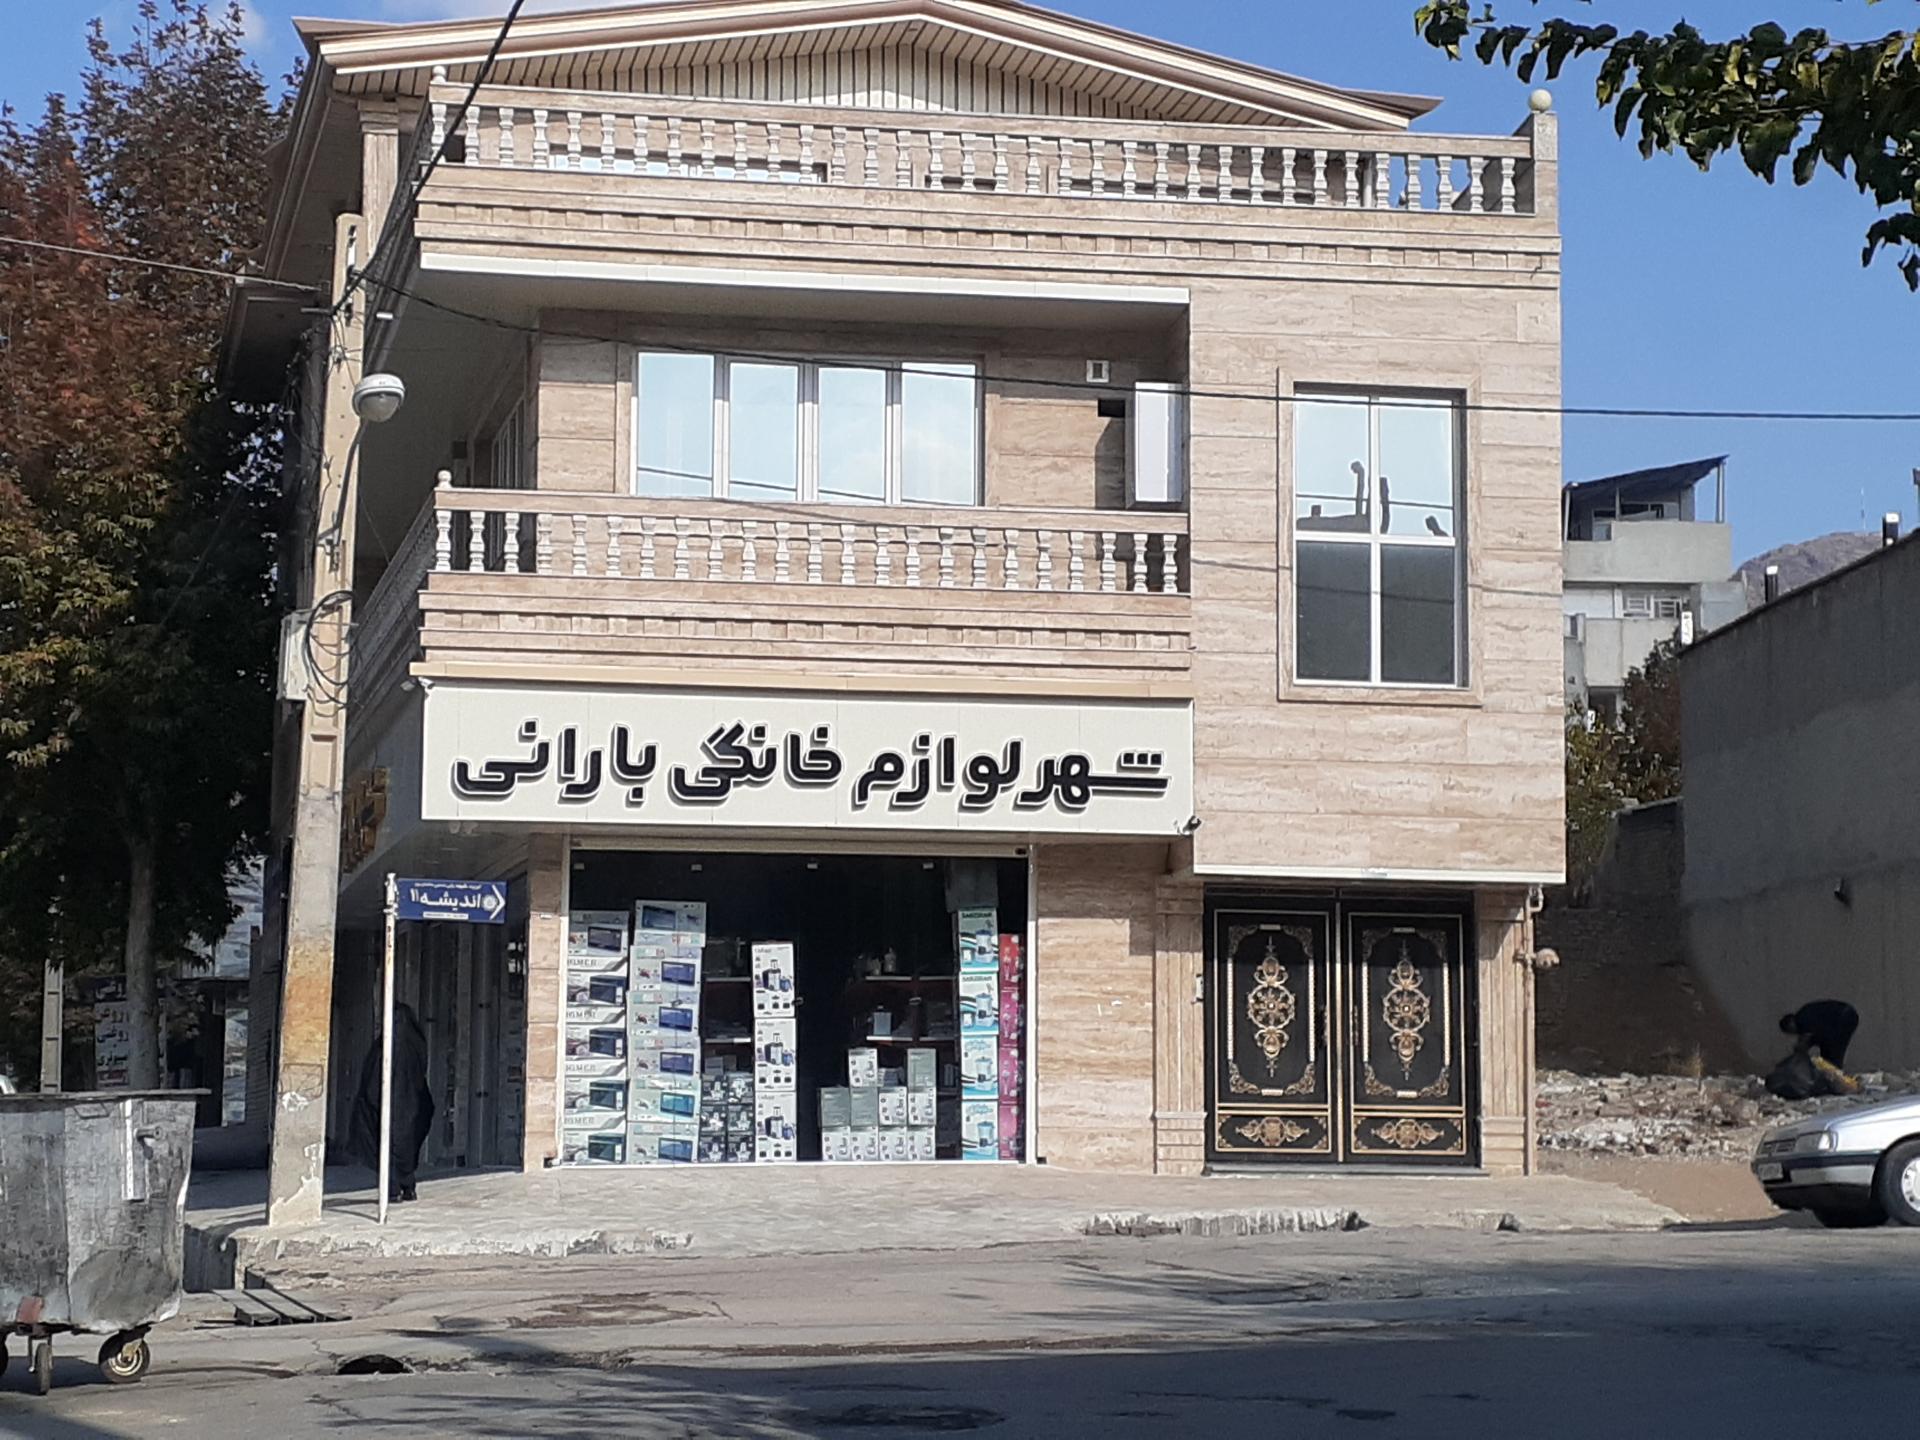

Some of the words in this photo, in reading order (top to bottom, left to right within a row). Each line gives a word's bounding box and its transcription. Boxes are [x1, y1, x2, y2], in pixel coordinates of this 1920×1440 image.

[454, 718, 658, 802] بارانی
[671, 721, 843, 800] خانگی
[856, 731, 1023, 808] لوازم
[1018, 751, 1169, 807] شهر
[419, 890, 482, 911] اندیشه
